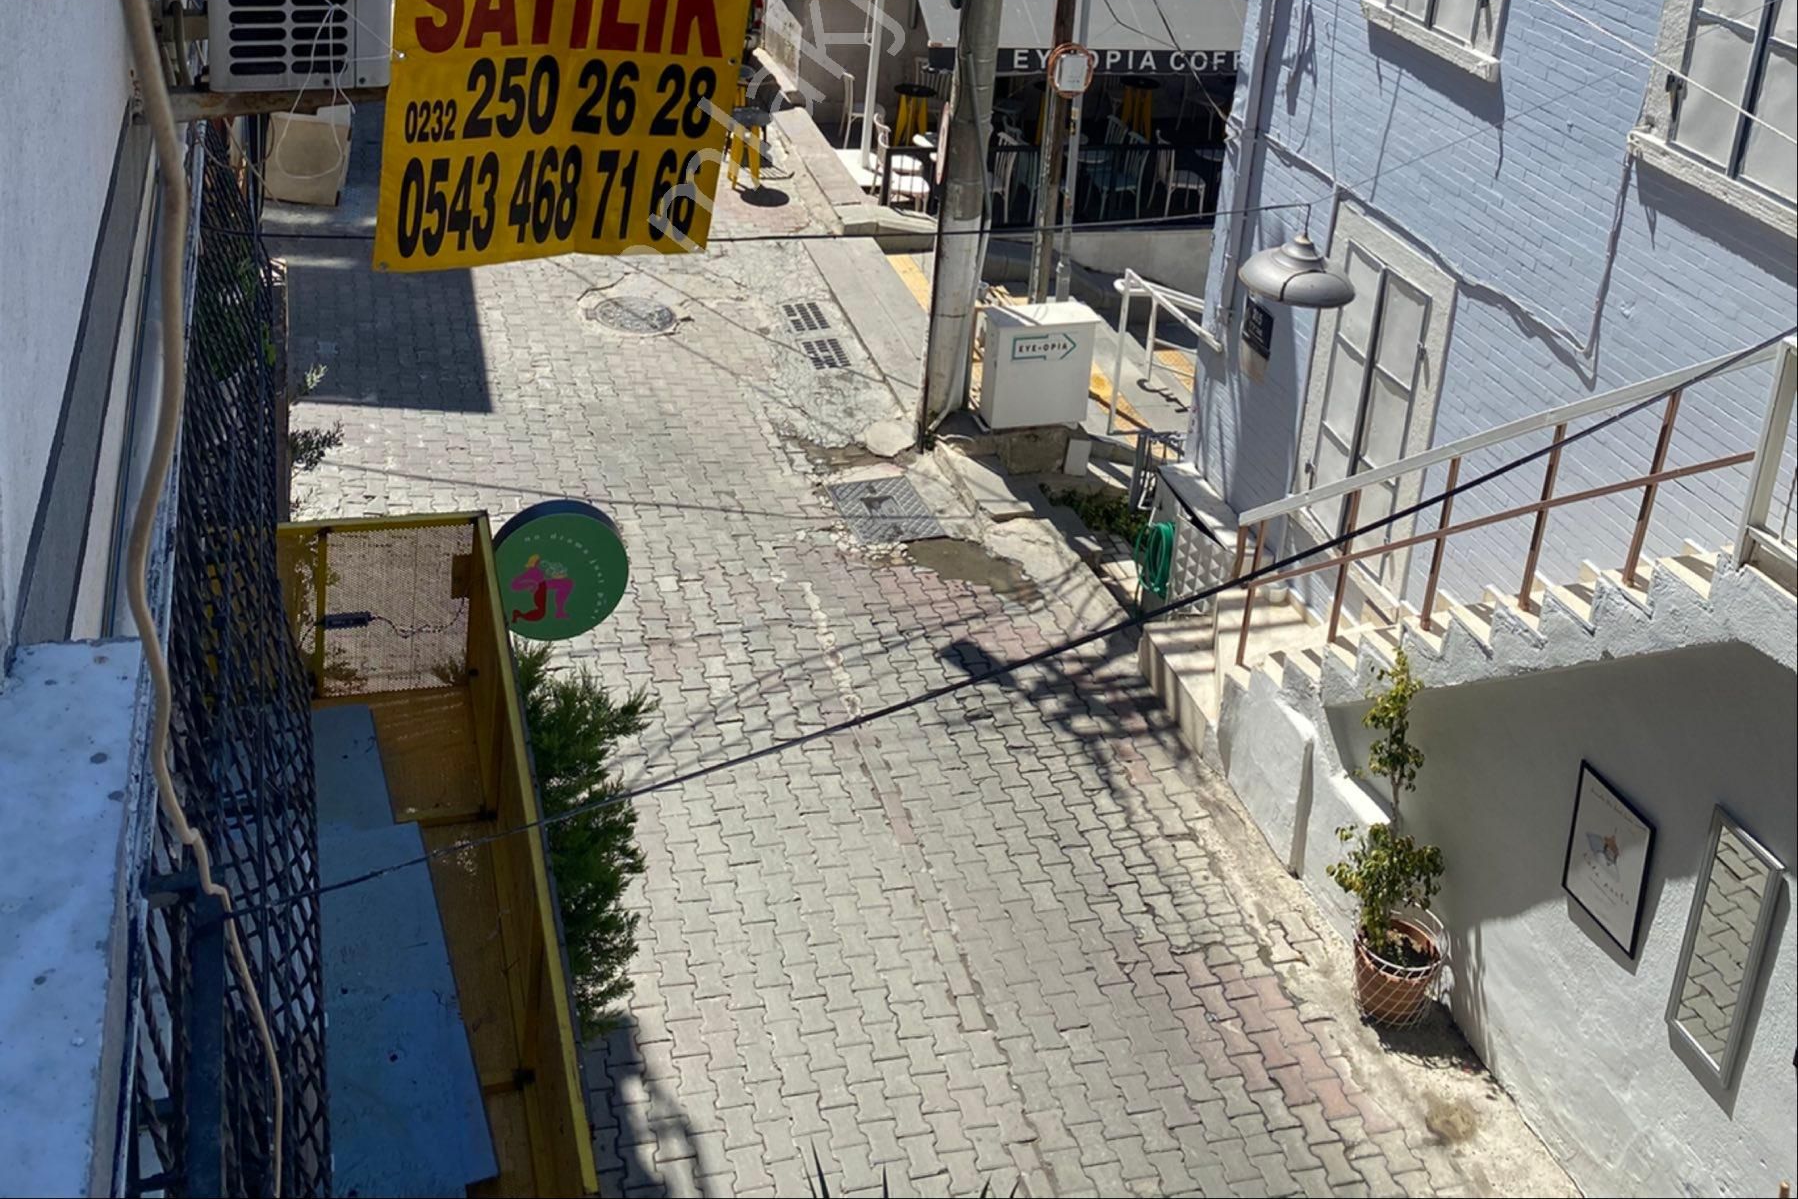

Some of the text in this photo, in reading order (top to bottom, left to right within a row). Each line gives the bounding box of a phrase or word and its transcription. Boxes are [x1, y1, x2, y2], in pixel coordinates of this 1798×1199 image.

[404, 55, 717, 143] 0232 250 26 28
[397, 150, 499, 259] 0543
[508, 144, 582, 245] 468
[591, 149, 639, 240] 71
